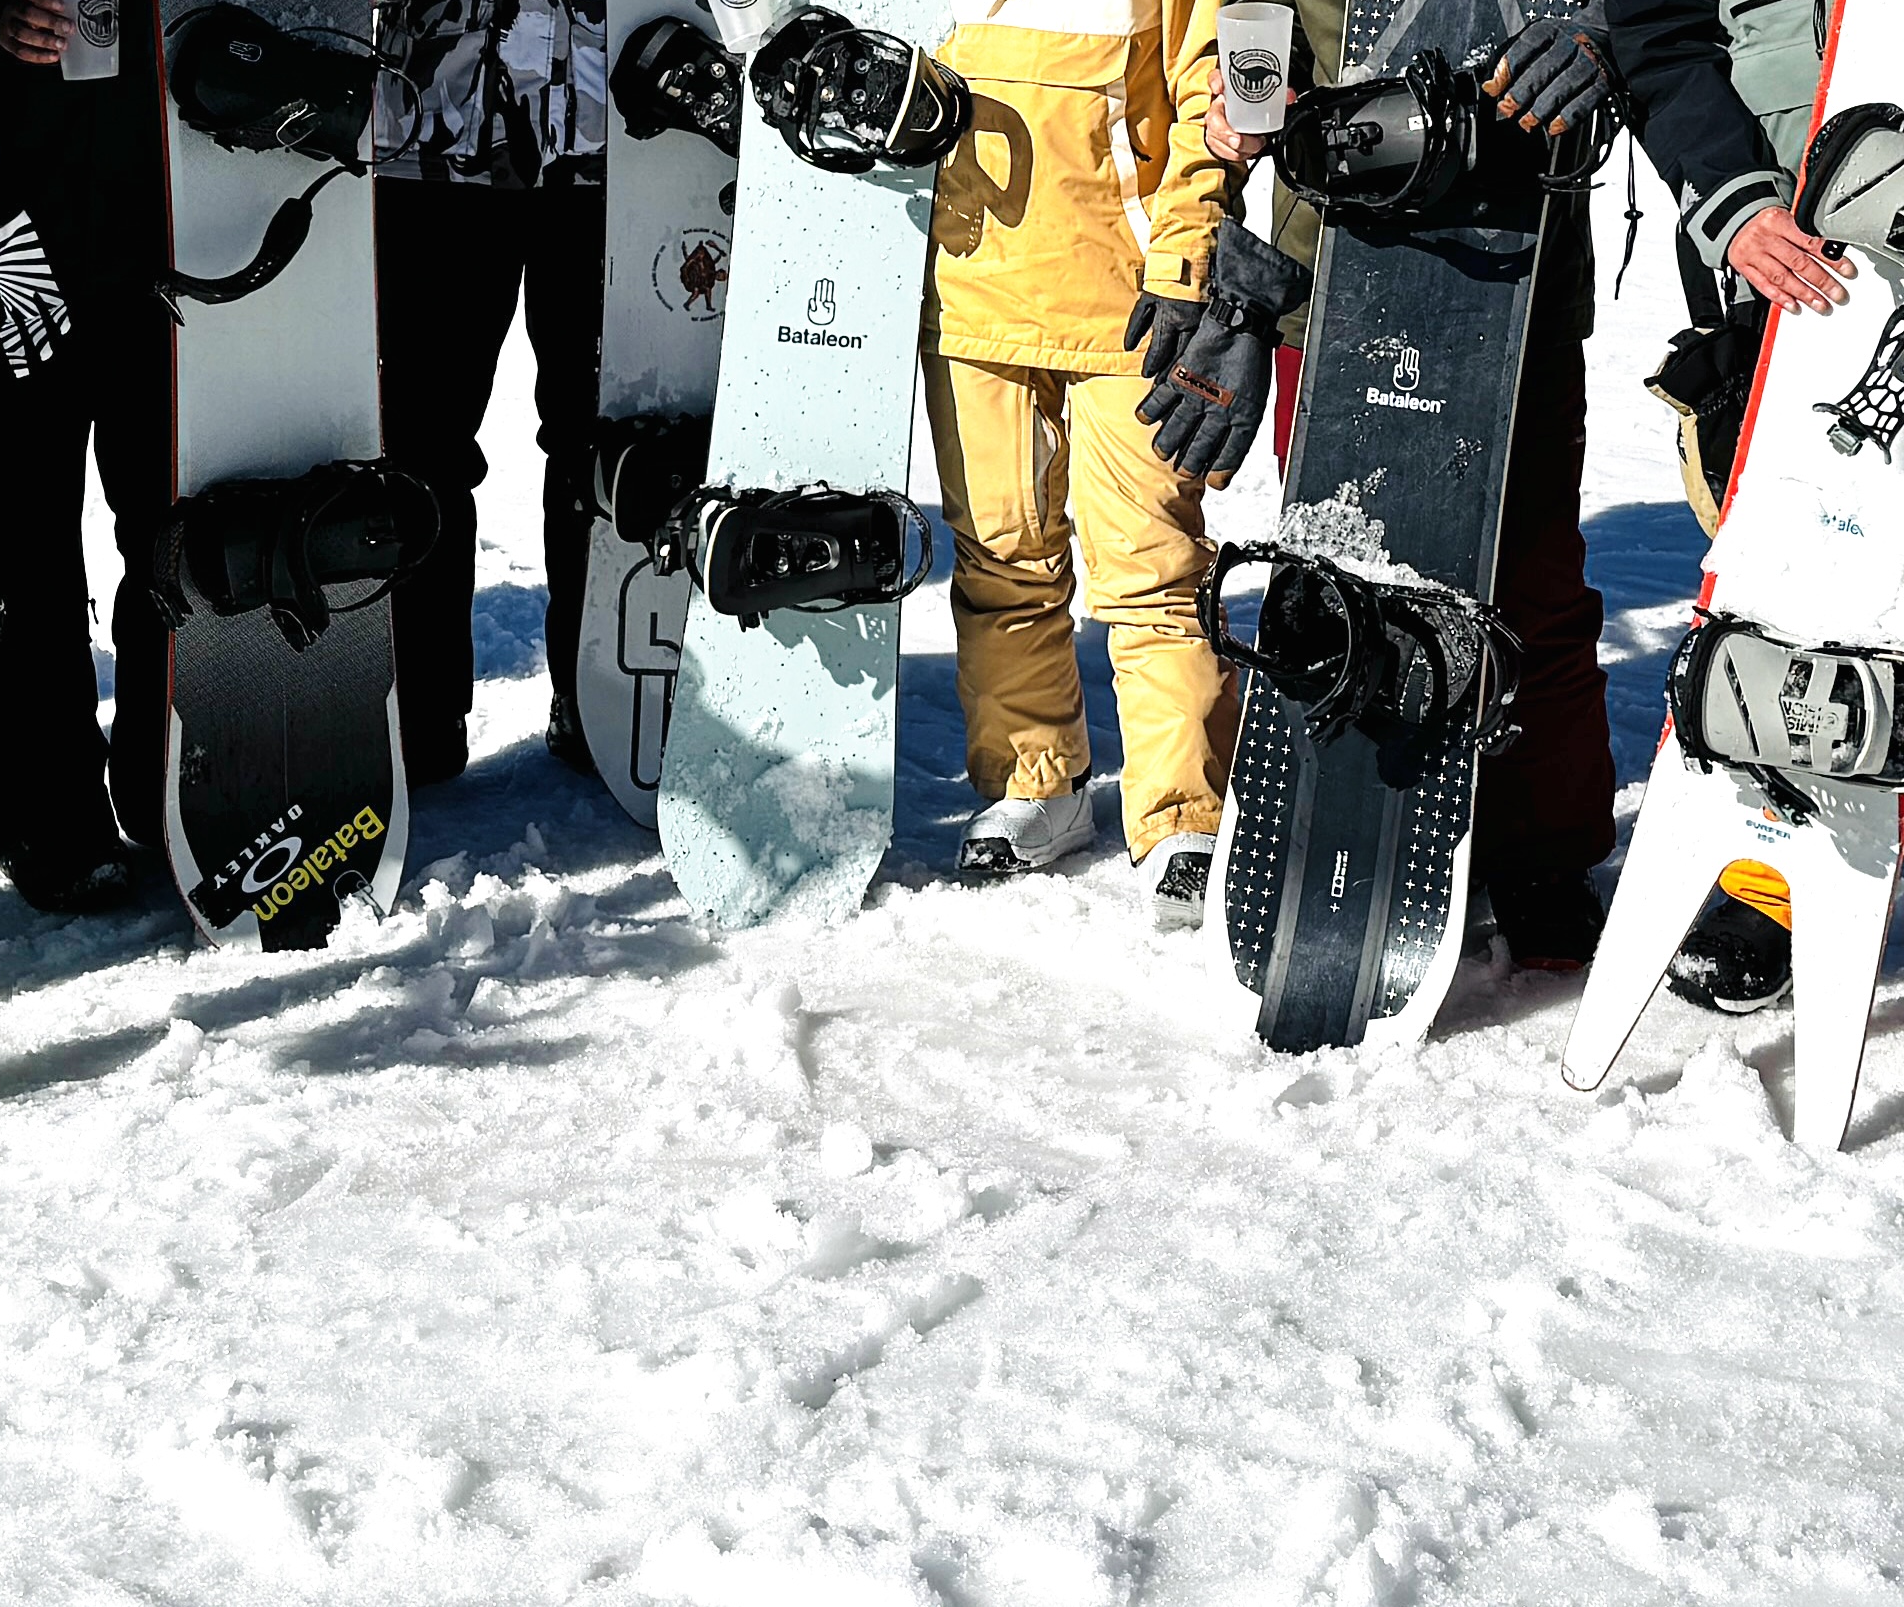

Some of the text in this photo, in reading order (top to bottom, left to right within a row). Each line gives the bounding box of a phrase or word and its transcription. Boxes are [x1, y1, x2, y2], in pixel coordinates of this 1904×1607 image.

[777, 325, 863, 350] Bataleon
[1365, 386, 1442, 414] Bataleon
[213, 804, 304, 891] OAKLEY
[252, 805, 386, 922] Bataleon
